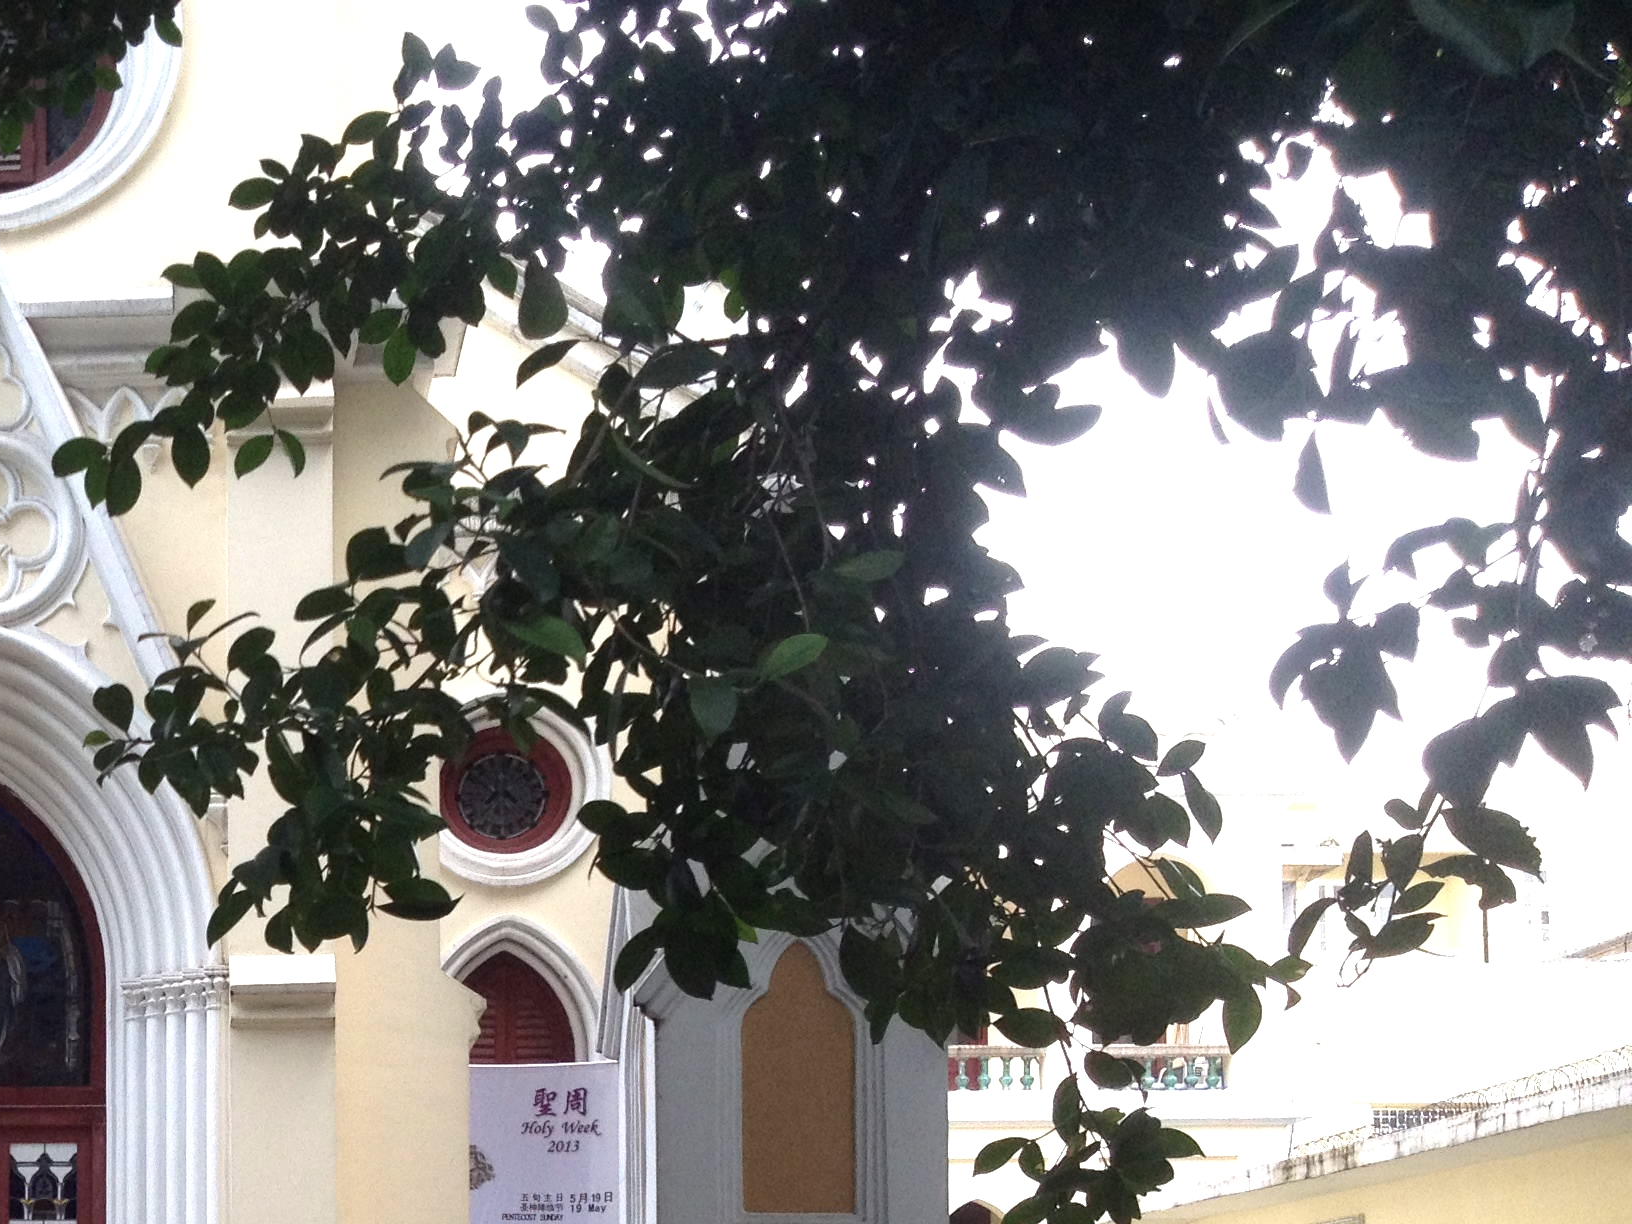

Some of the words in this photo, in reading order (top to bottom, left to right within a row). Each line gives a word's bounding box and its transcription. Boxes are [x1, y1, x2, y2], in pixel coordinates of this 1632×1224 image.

[521, 1120, 554, 1138] Holy
[562, 1119, 602, 1136] Week
[547, 1140, 580, 1153] 2013
[570, 1204, 582, 1213] 19
[588, 1204, 606, 1213] May
